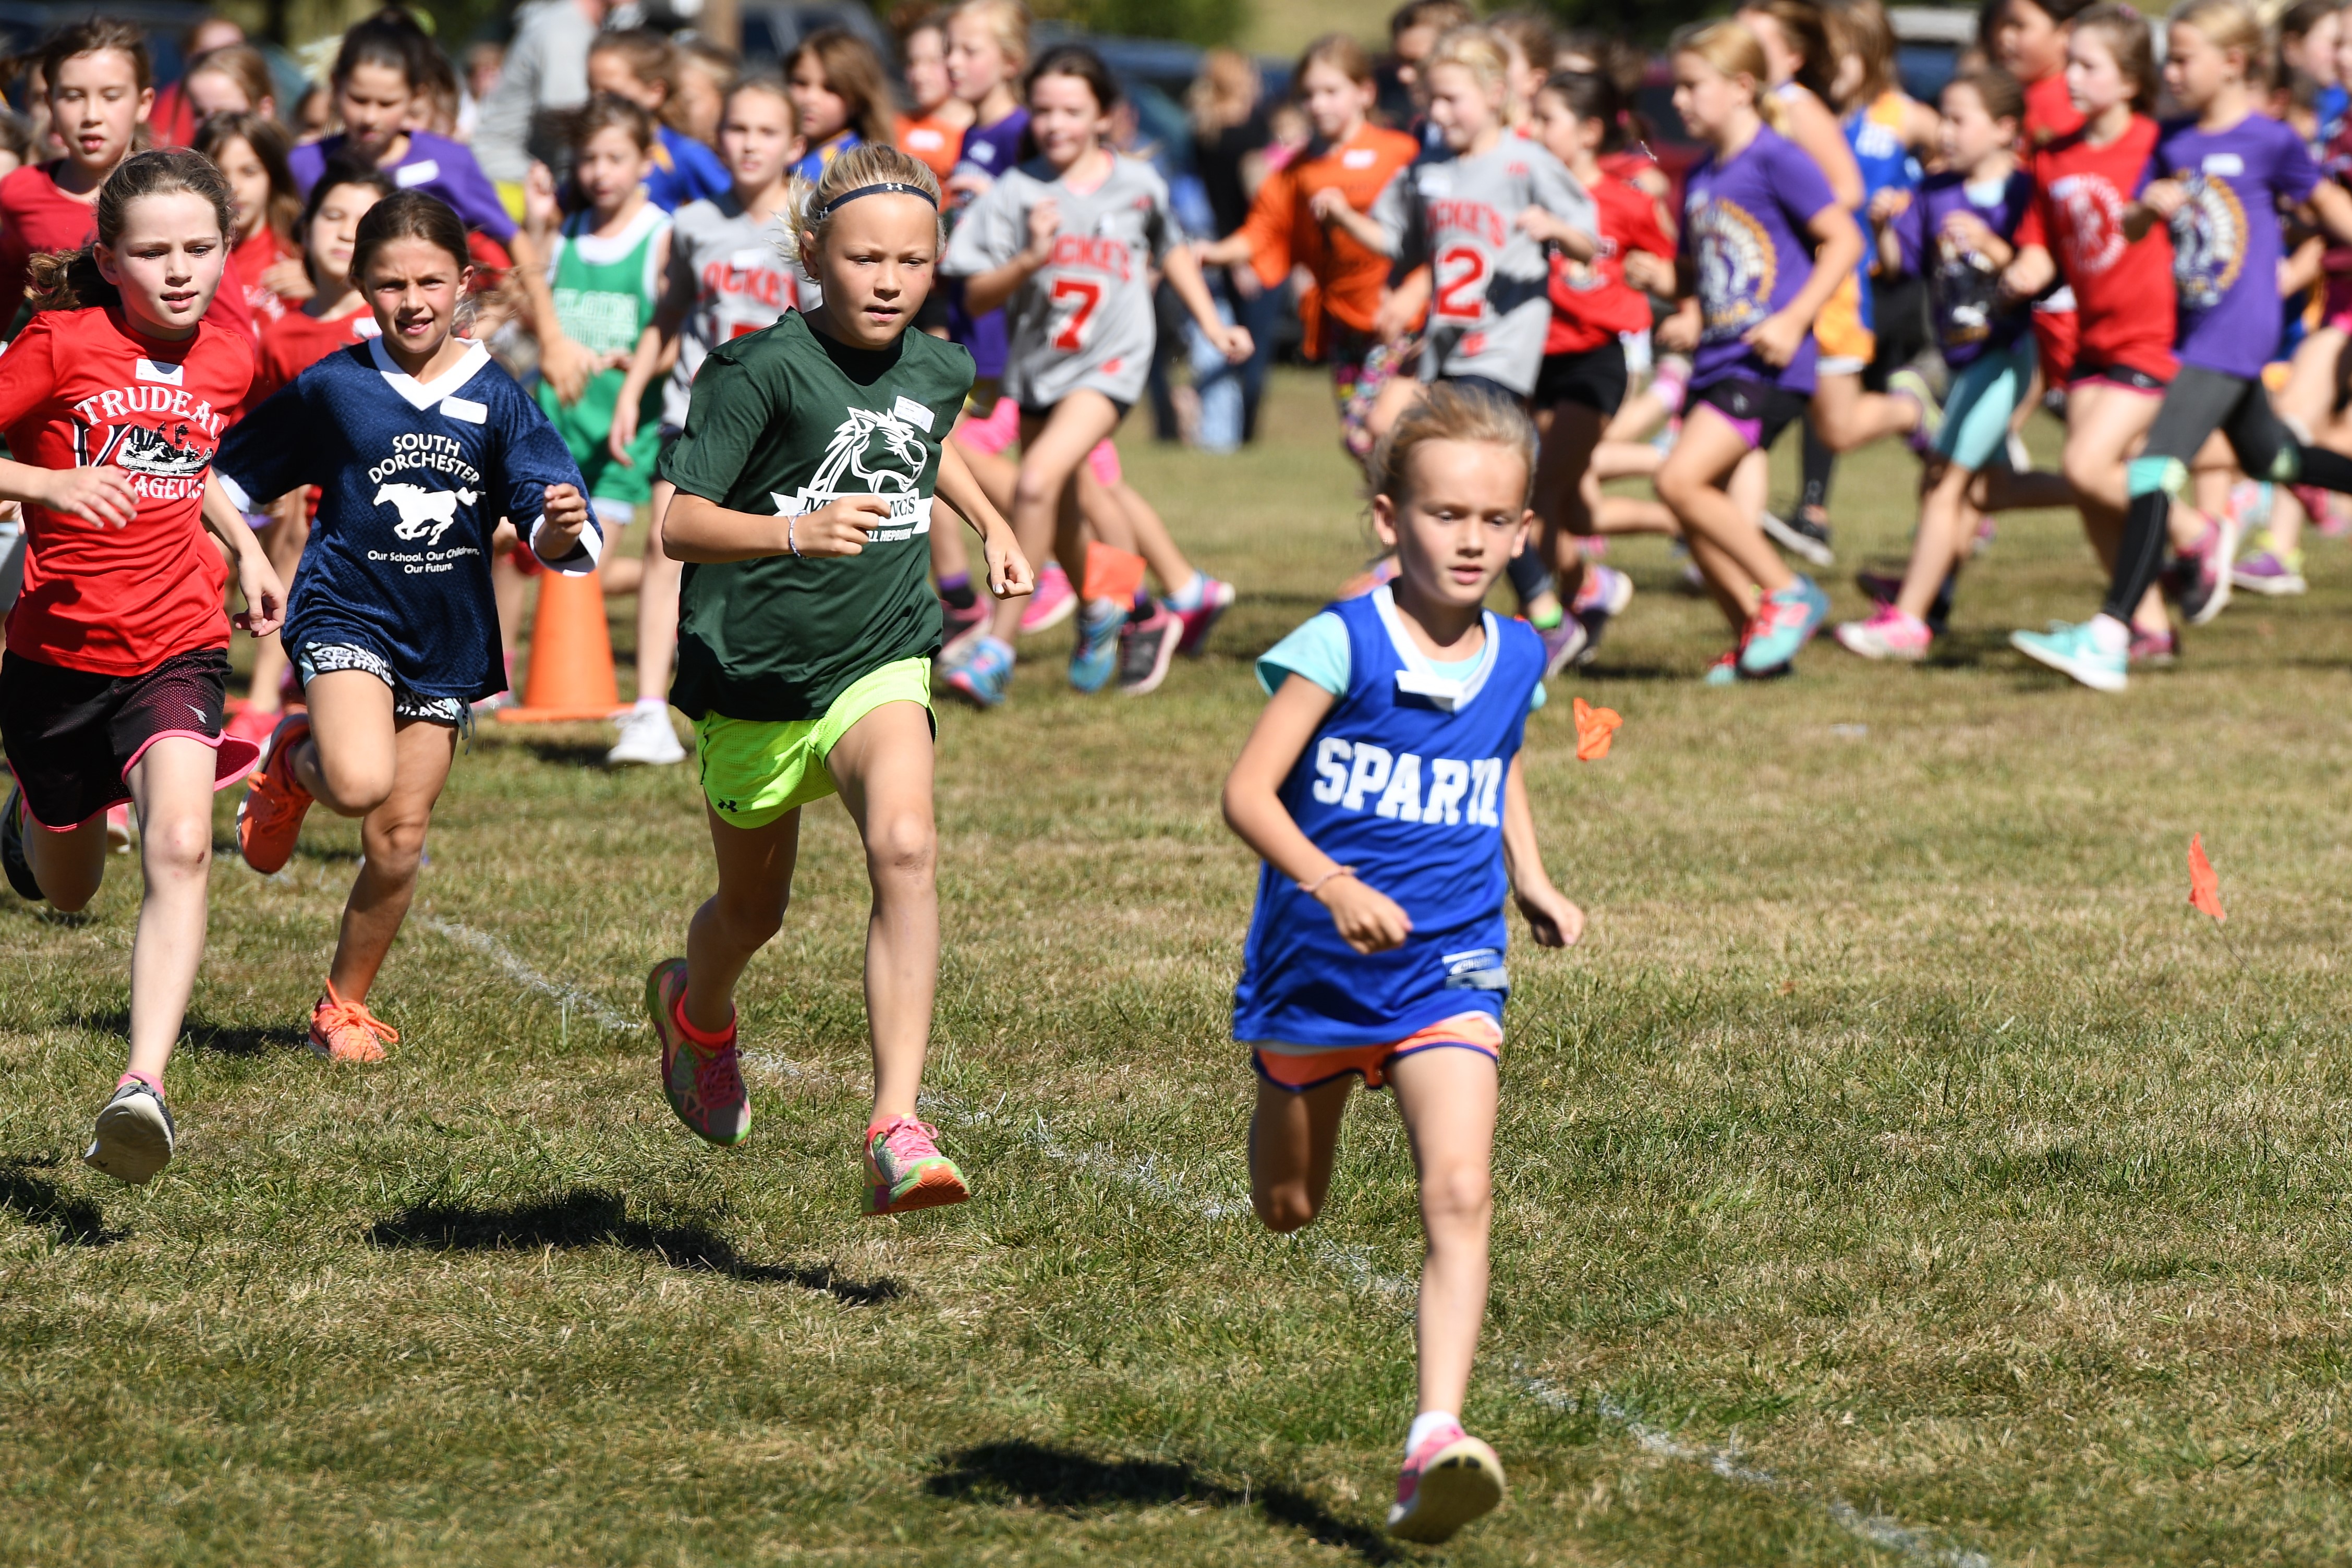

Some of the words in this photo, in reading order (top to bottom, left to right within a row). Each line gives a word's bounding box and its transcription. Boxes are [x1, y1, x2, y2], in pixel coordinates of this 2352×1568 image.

[1438, 247, 1482, 317] 2
[1052, 279, 1100, 350] 7
[392, 433, 460, 457] SOUTH
[368, 452, 480, 484] DORCHESTER
[368, 550, 387, 561] Our
[426, 551, 445, 561] Our
[404, 564, 423, 574] Our
